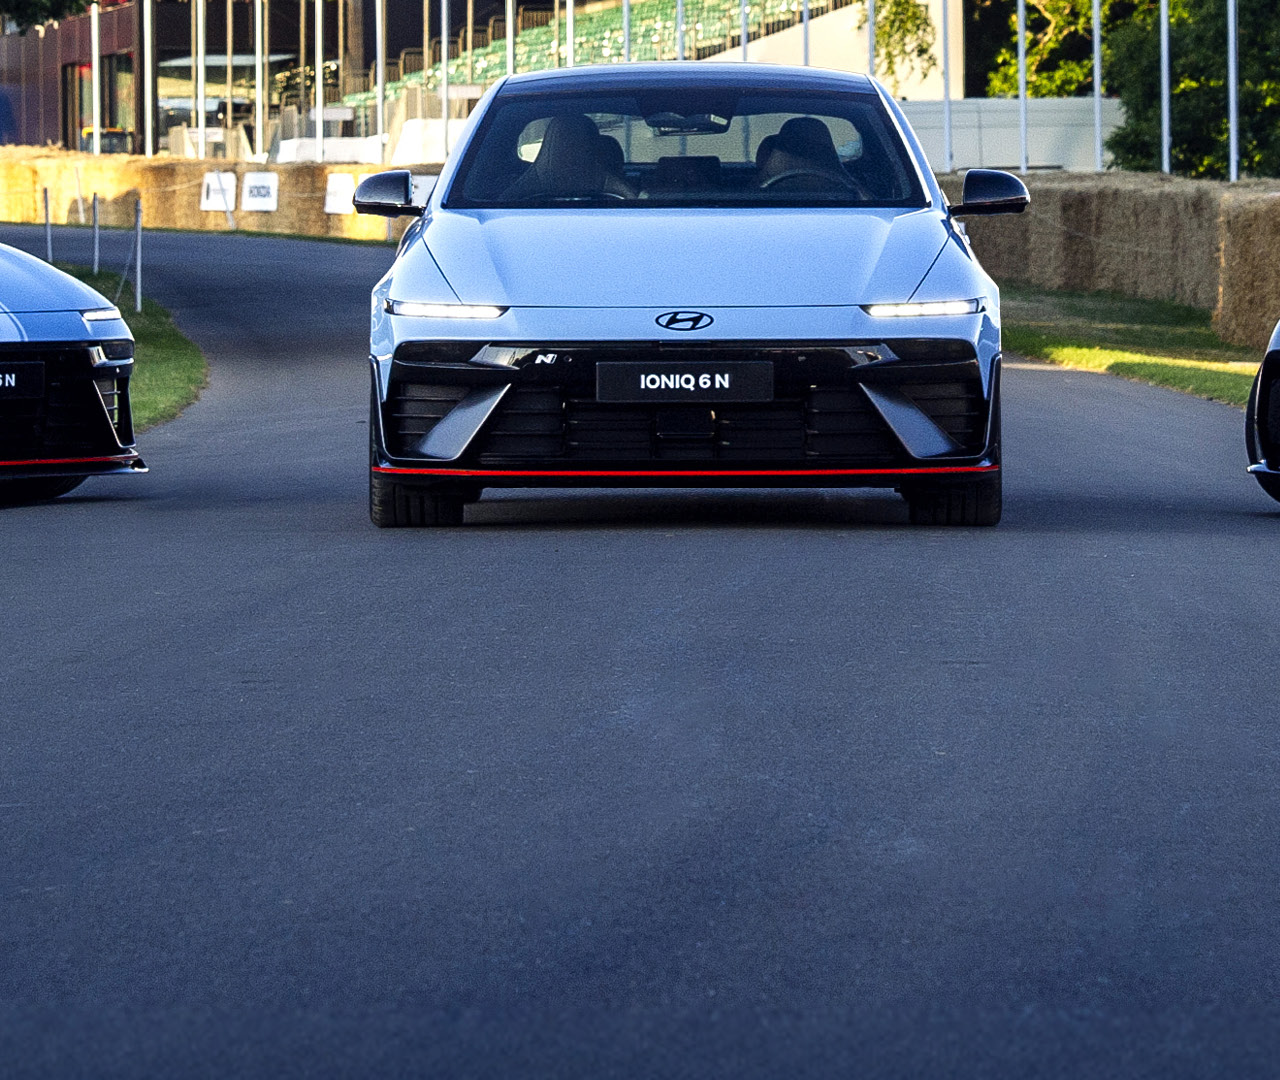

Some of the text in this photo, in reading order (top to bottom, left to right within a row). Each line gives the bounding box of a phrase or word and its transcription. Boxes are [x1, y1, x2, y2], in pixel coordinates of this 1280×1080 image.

[5, 373, 16, 387] N
[639, 373, 730, 391] IONIQ 6 N
